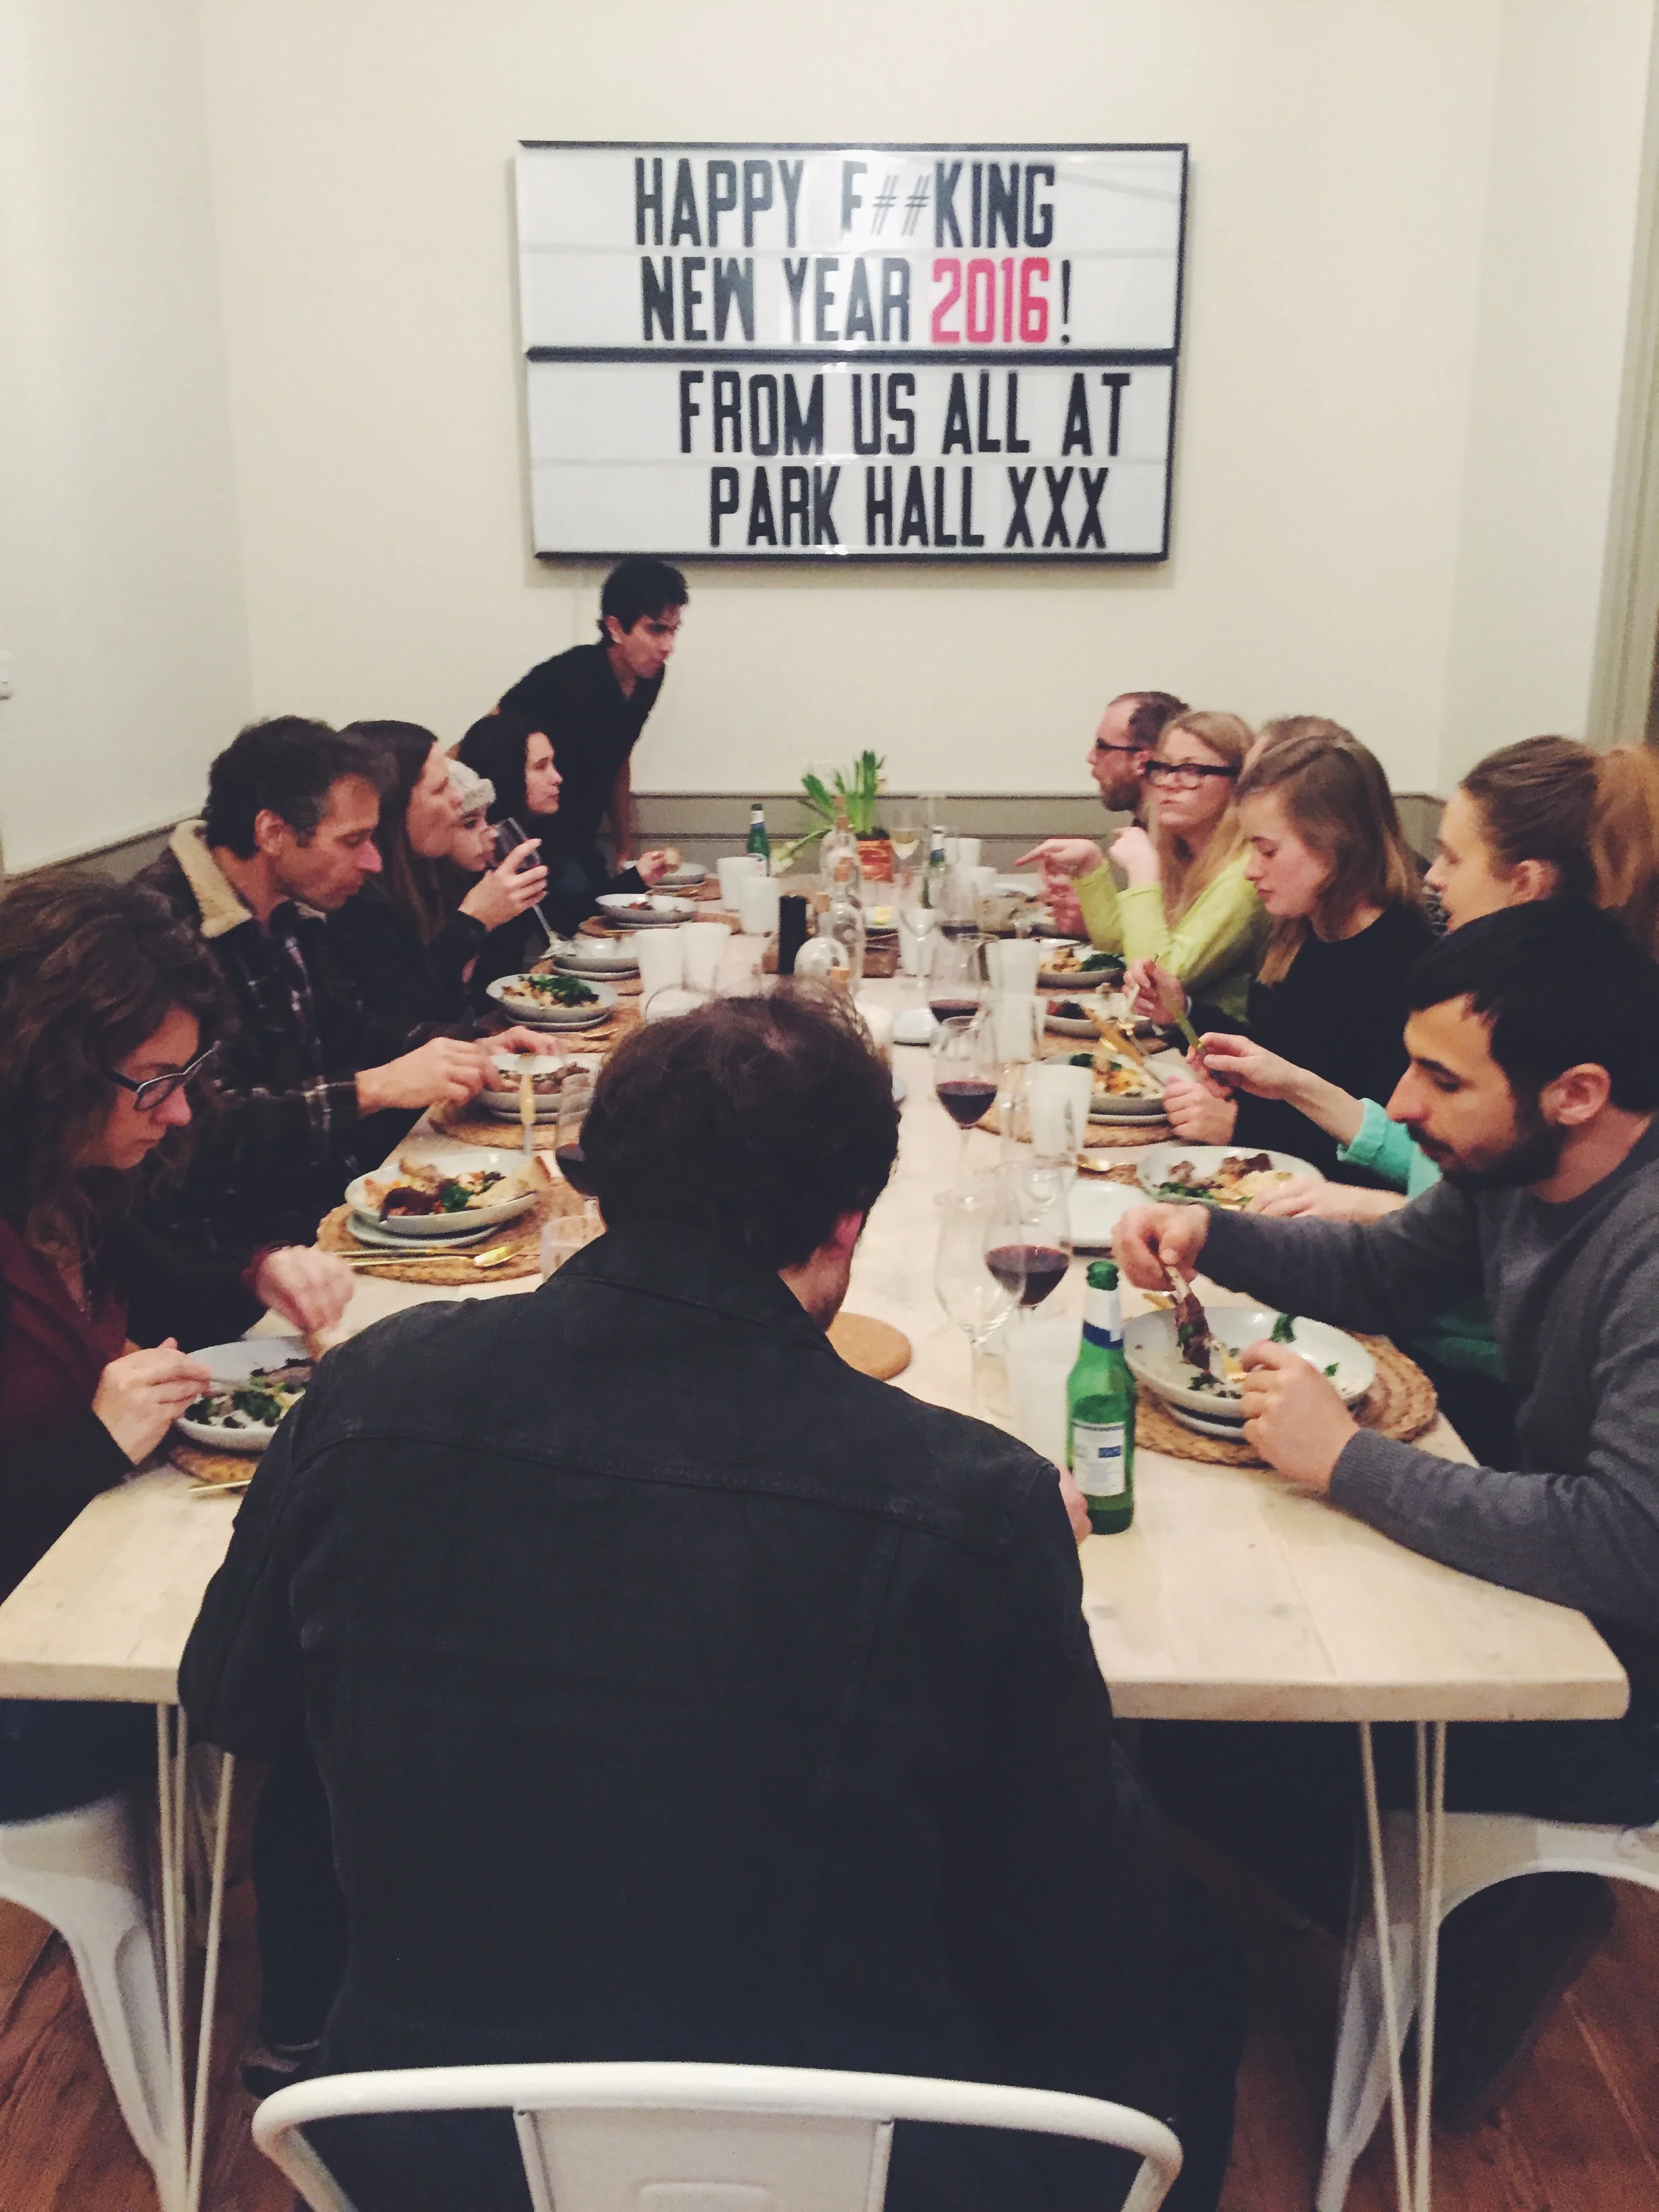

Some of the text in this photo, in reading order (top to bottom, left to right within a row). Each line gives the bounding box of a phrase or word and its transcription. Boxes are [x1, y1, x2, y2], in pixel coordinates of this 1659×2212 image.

[635, 157, 1055, 249] HAPPY F##KING
[639, 256, 1071, 344] NEW YEAR 2016!
[679, 369, 1130, 456] FROM US ALL AT
[709, 466, 1109, 549] PARK HALL XXX
